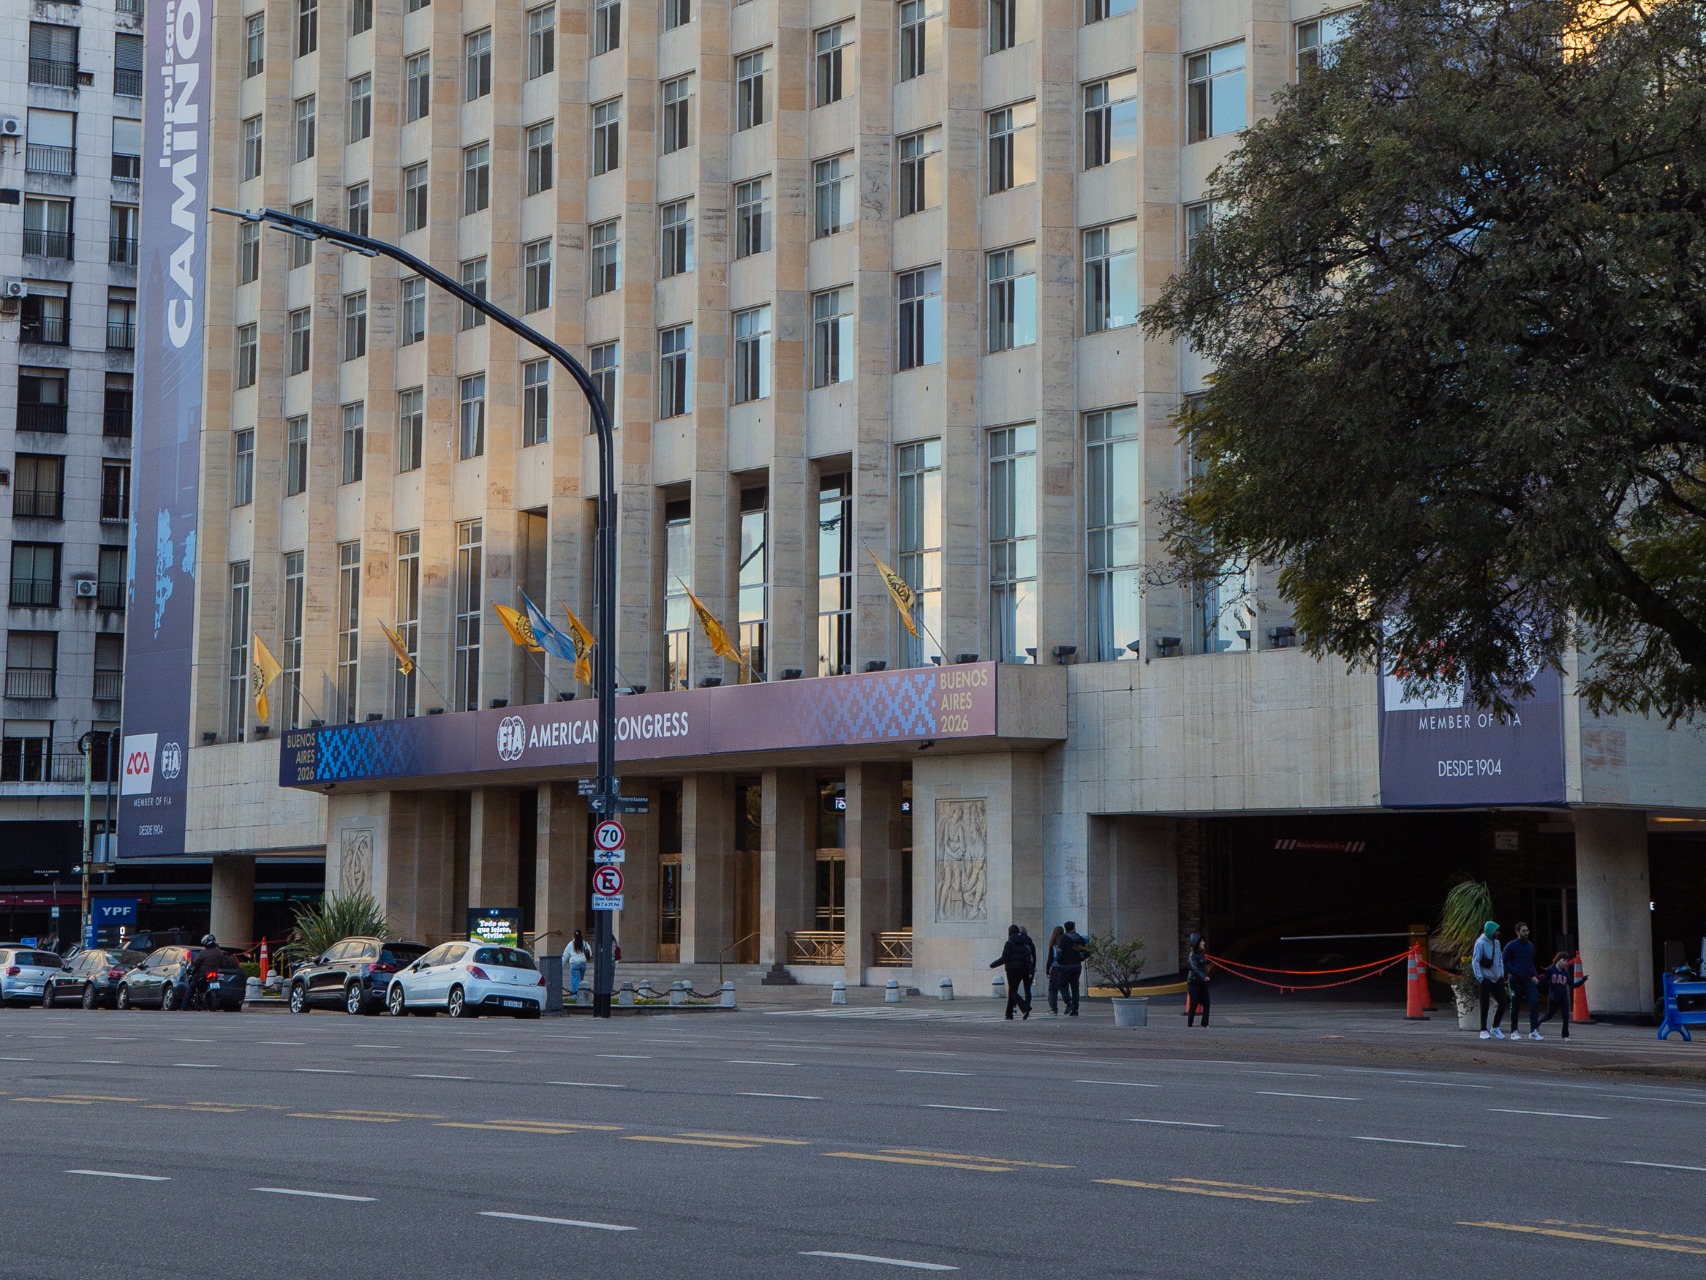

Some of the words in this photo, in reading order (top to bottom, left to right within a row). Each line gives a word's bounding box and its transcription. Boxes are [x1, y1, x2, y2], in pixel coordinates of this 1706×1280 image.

[940, 668, 988, 690] BUENOS
[941, 692, 973, 711] AIRES
[613, 711, 689, 740] ONGRESS
[940, 714, 969, 733] 2026
[1419, 715, 1471, 730] MEMBER
[1477, 713, 1494, 728] OF
[1500, 712, 1522, 727] IA
[287, 732, 316, 748] BUENOS
[126, 751, 150, 775] ACA
[296, 750, 315, 764] AIRES
[297, 766, 315, 782] 2026
[1438, 759, 1474, 777] DESDE
[1475, 758, 1502, 776] 1904
[133, 798, 154, 807] MEMBER
[155, 797, 162, 806] OF
[163, 796, 172, 805] FIA
[138, 825, 153, 836] DESDE
[153, 824, 163, 835] 1904
[601, 830, 618, 843] 70
[102, 907, 131, 916] YPF
